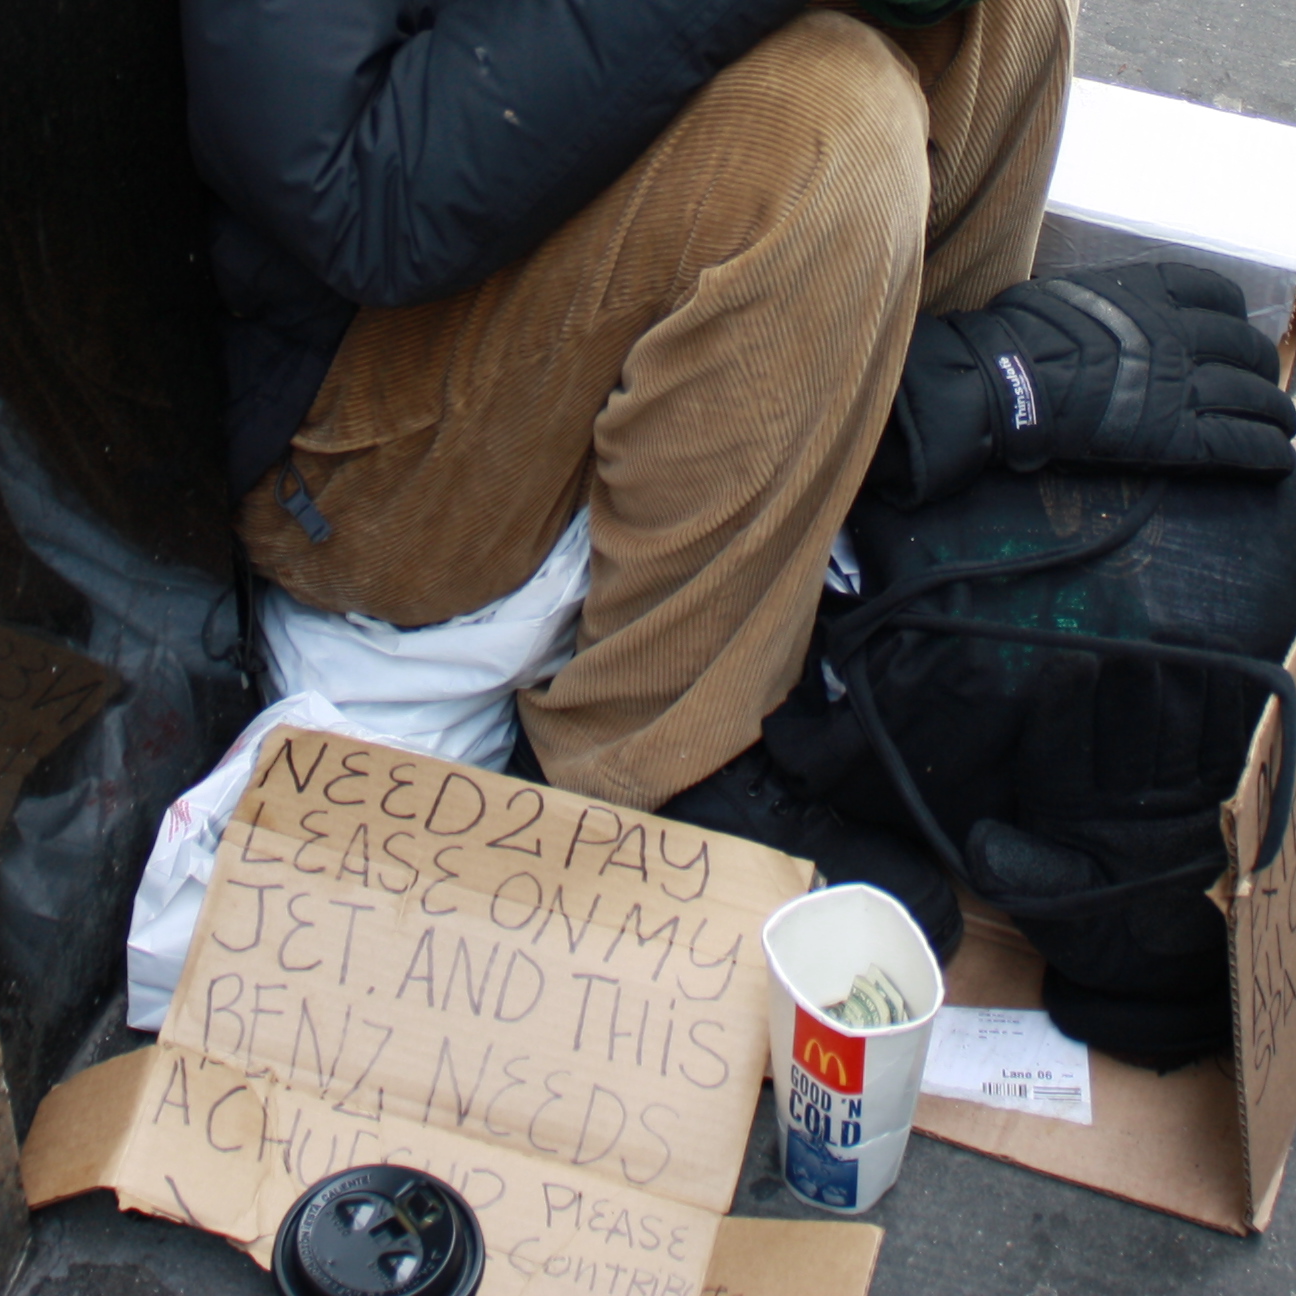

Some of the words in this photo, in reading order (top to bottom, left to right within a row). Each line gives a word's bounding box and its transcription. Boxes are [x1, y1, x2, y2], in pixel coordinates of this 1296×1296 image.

[998, 356, 1028, 430] Thinsulate
[258, 738, 486, 835] NEED
[486, 788, 543, 857] 2
[564, 805, 710, 902] PAY
[241, 801, 461, 915] LEASE
[490, 871, 601, 953] ON
[603, 902, 743, 1000] MY
[395, 925, 544, 1022] AND
[153, 1056, 189, 1125] A
[200, 972, 394, 1121] BENZ
[422, 1036, 680, 1184] NEEDS
[791, 1064, 832, 1113] GOOD
[1002, 1069, 1032, 1079] Lane
[789, 1088, 862, 1147] COLD
